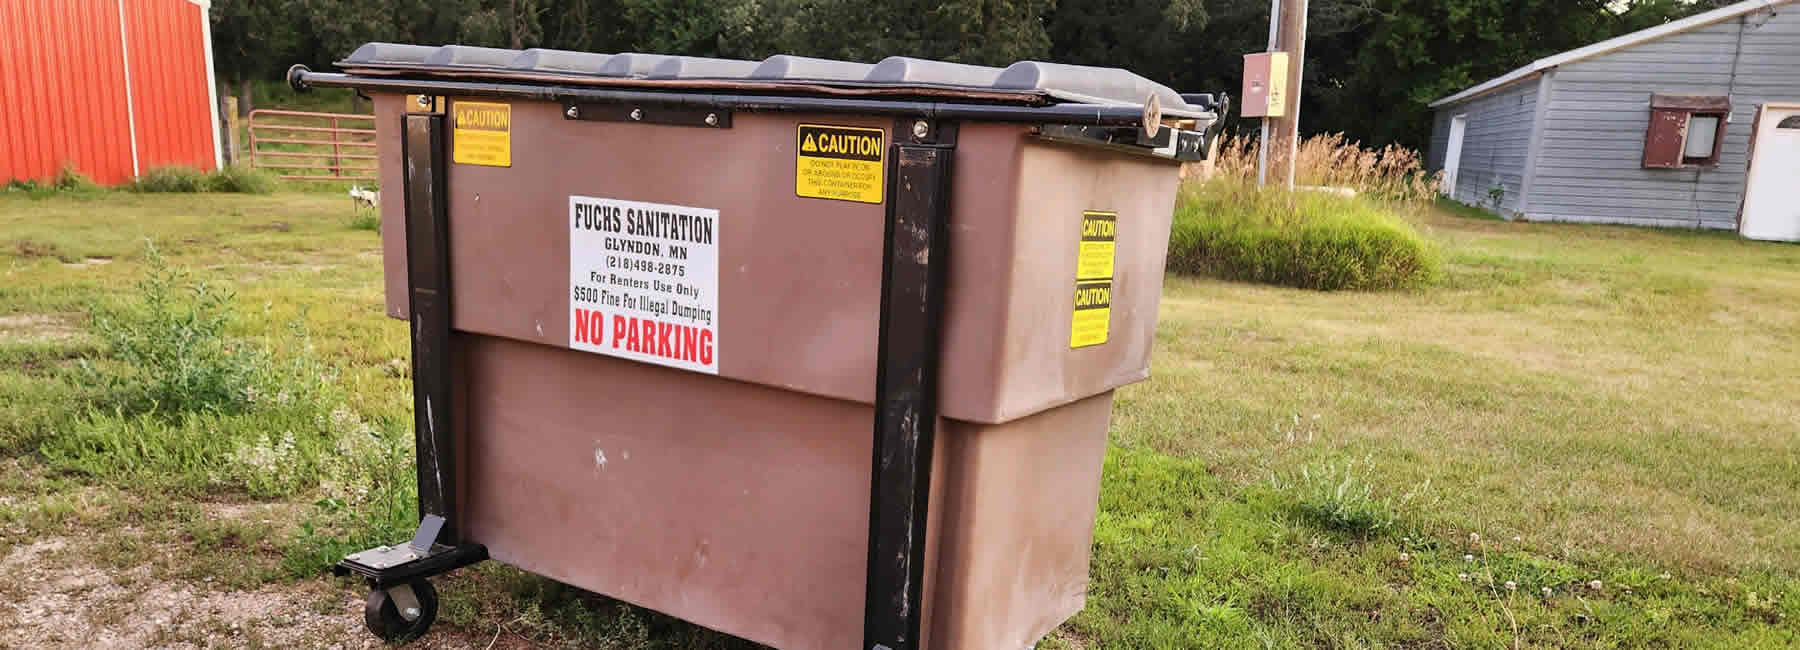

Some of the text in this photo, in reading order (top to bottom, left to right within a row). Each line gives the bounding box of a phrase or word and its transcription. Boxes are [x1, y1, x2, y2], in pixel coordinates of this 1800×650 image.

[466, 110, 508, 129] CAUTION
[818, 133, 881, 156] CAUTION
[575, 203, 713, 244] FUCHS SANITATION
[1083, 219, 1115, 237] CAUTION
[669, 246, 688, 259] MN
[606, 255, 685, 277] (218)498-2875
[590, 271, 700, 300] For Renters Use Only
[574, 285, 712, 325] $500 Fine For Illegal Dumping
[1076, 288, 1110, 306] CAUTION
[575, 308, 713, 365] NO PARKING
